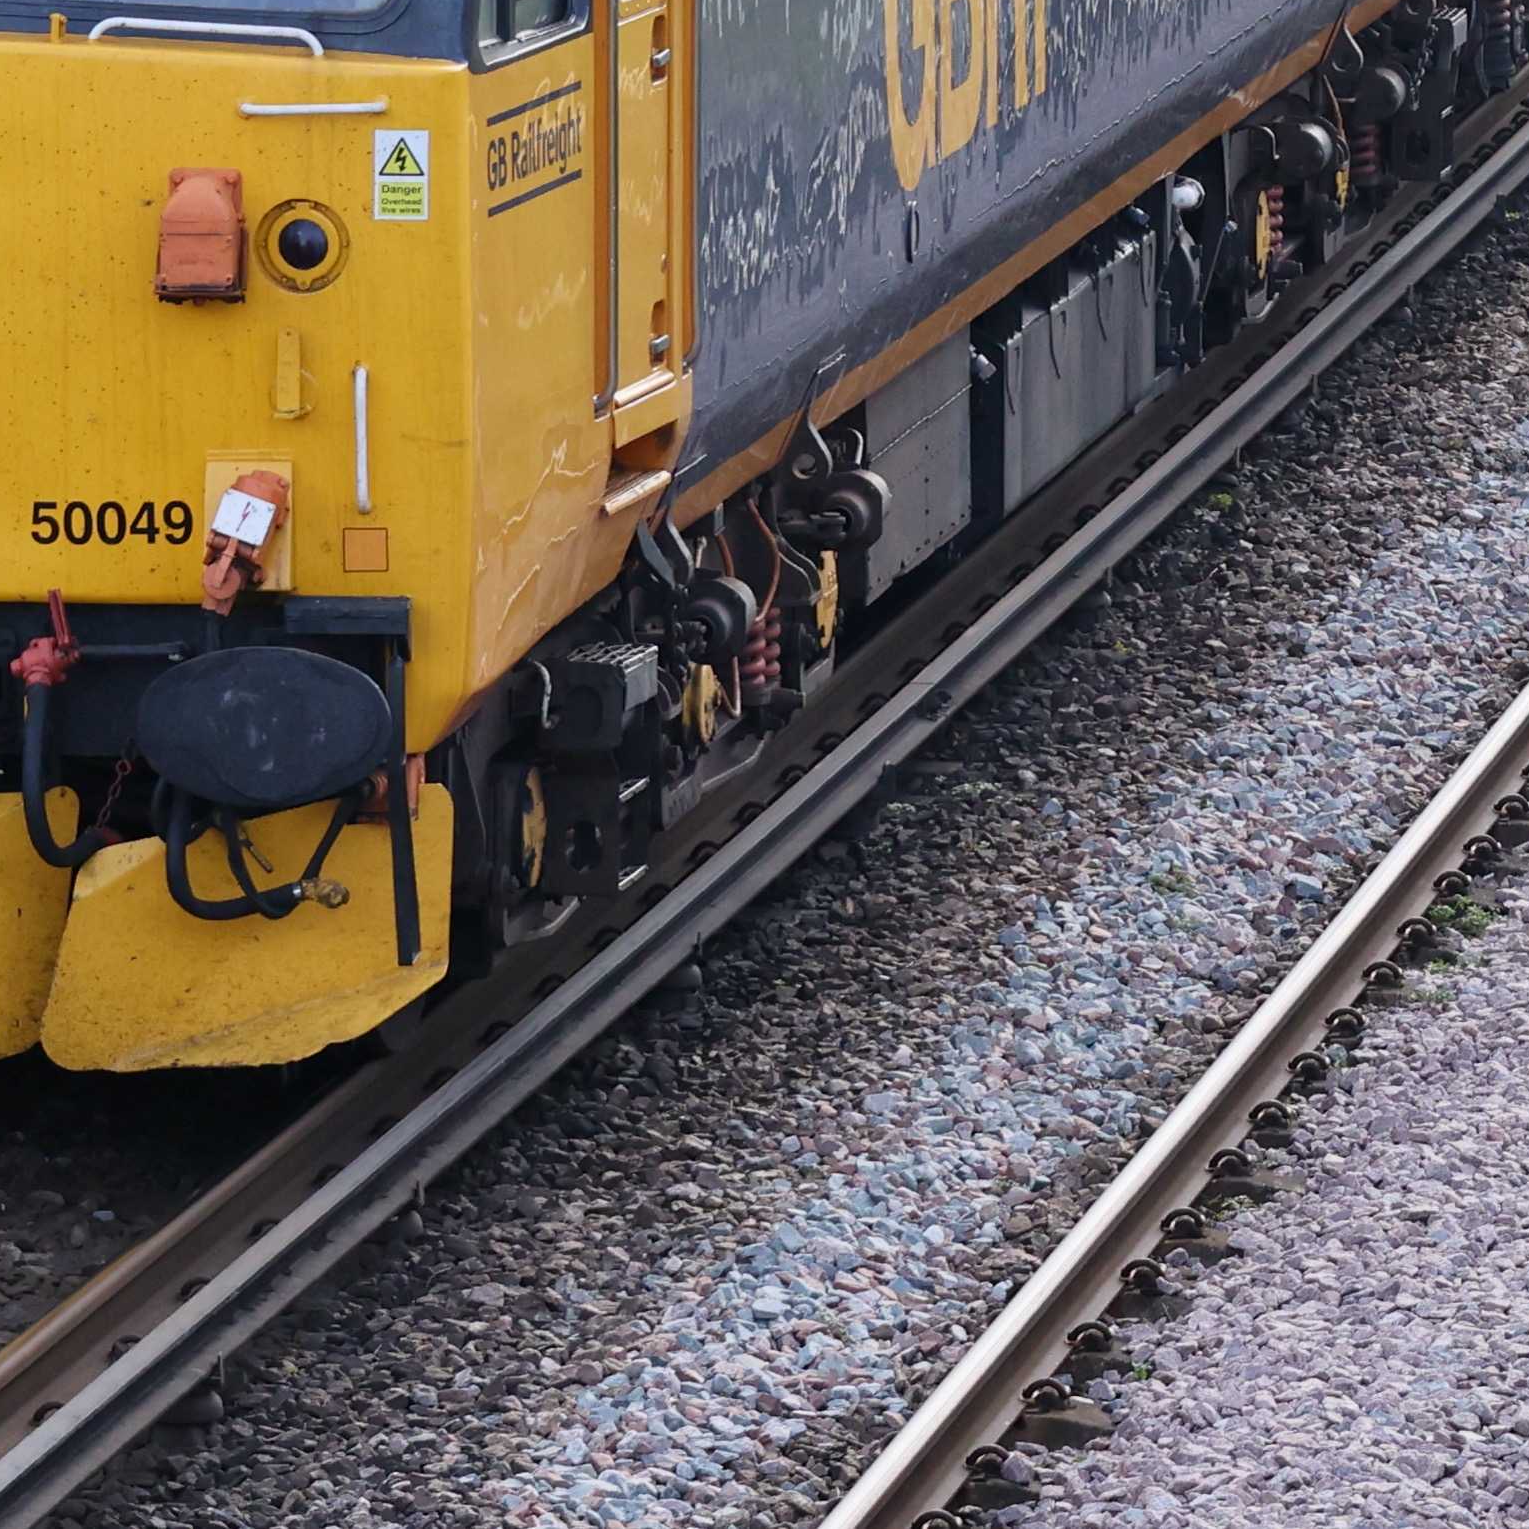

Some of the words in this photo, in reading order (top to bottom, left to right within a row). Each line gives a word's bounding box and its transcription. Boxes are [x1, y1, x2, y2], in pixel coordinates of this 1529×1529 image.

[487, 137, 507, 191] GB
[511, 105, 582, 182] Railfreight
[382, 184, 422, 196] Danger
[30, 500, 194, 545] 50049
